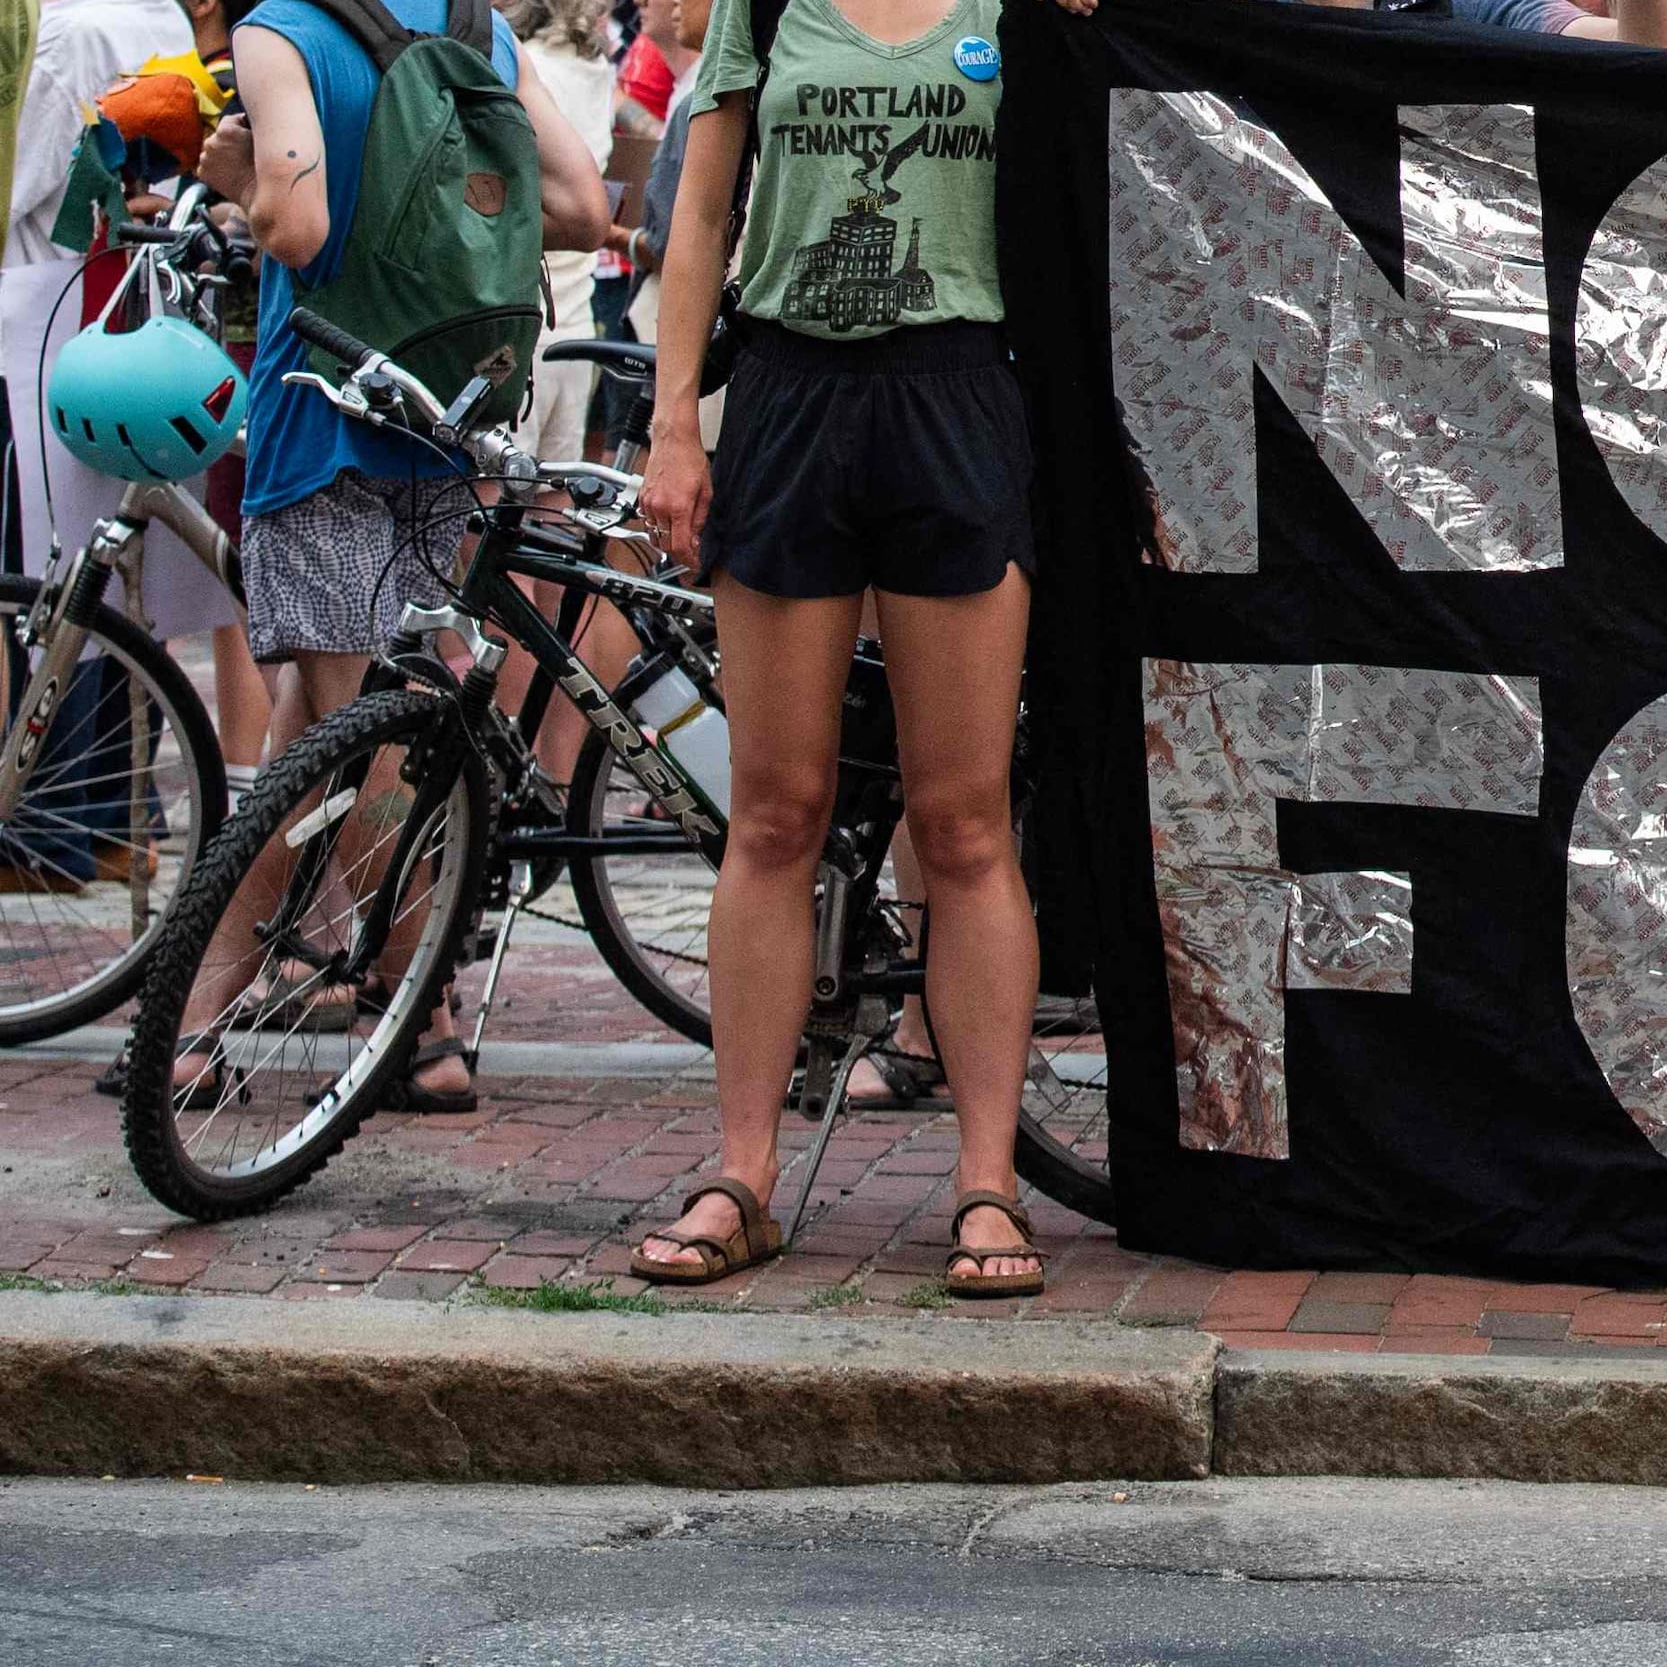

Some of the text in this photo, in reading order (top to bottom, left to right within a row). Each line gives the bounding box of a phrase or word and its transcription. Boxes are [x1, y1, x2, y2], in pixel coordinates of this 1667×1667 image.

[958, 47, 999, 67] COURAGE
[796, 83, 967, 119] PORTLAND
[771, 122, 1000, 162] TENANTS UNION
[601, 576, 694, 615] 820
[559, 656, 721, 844] TREK
